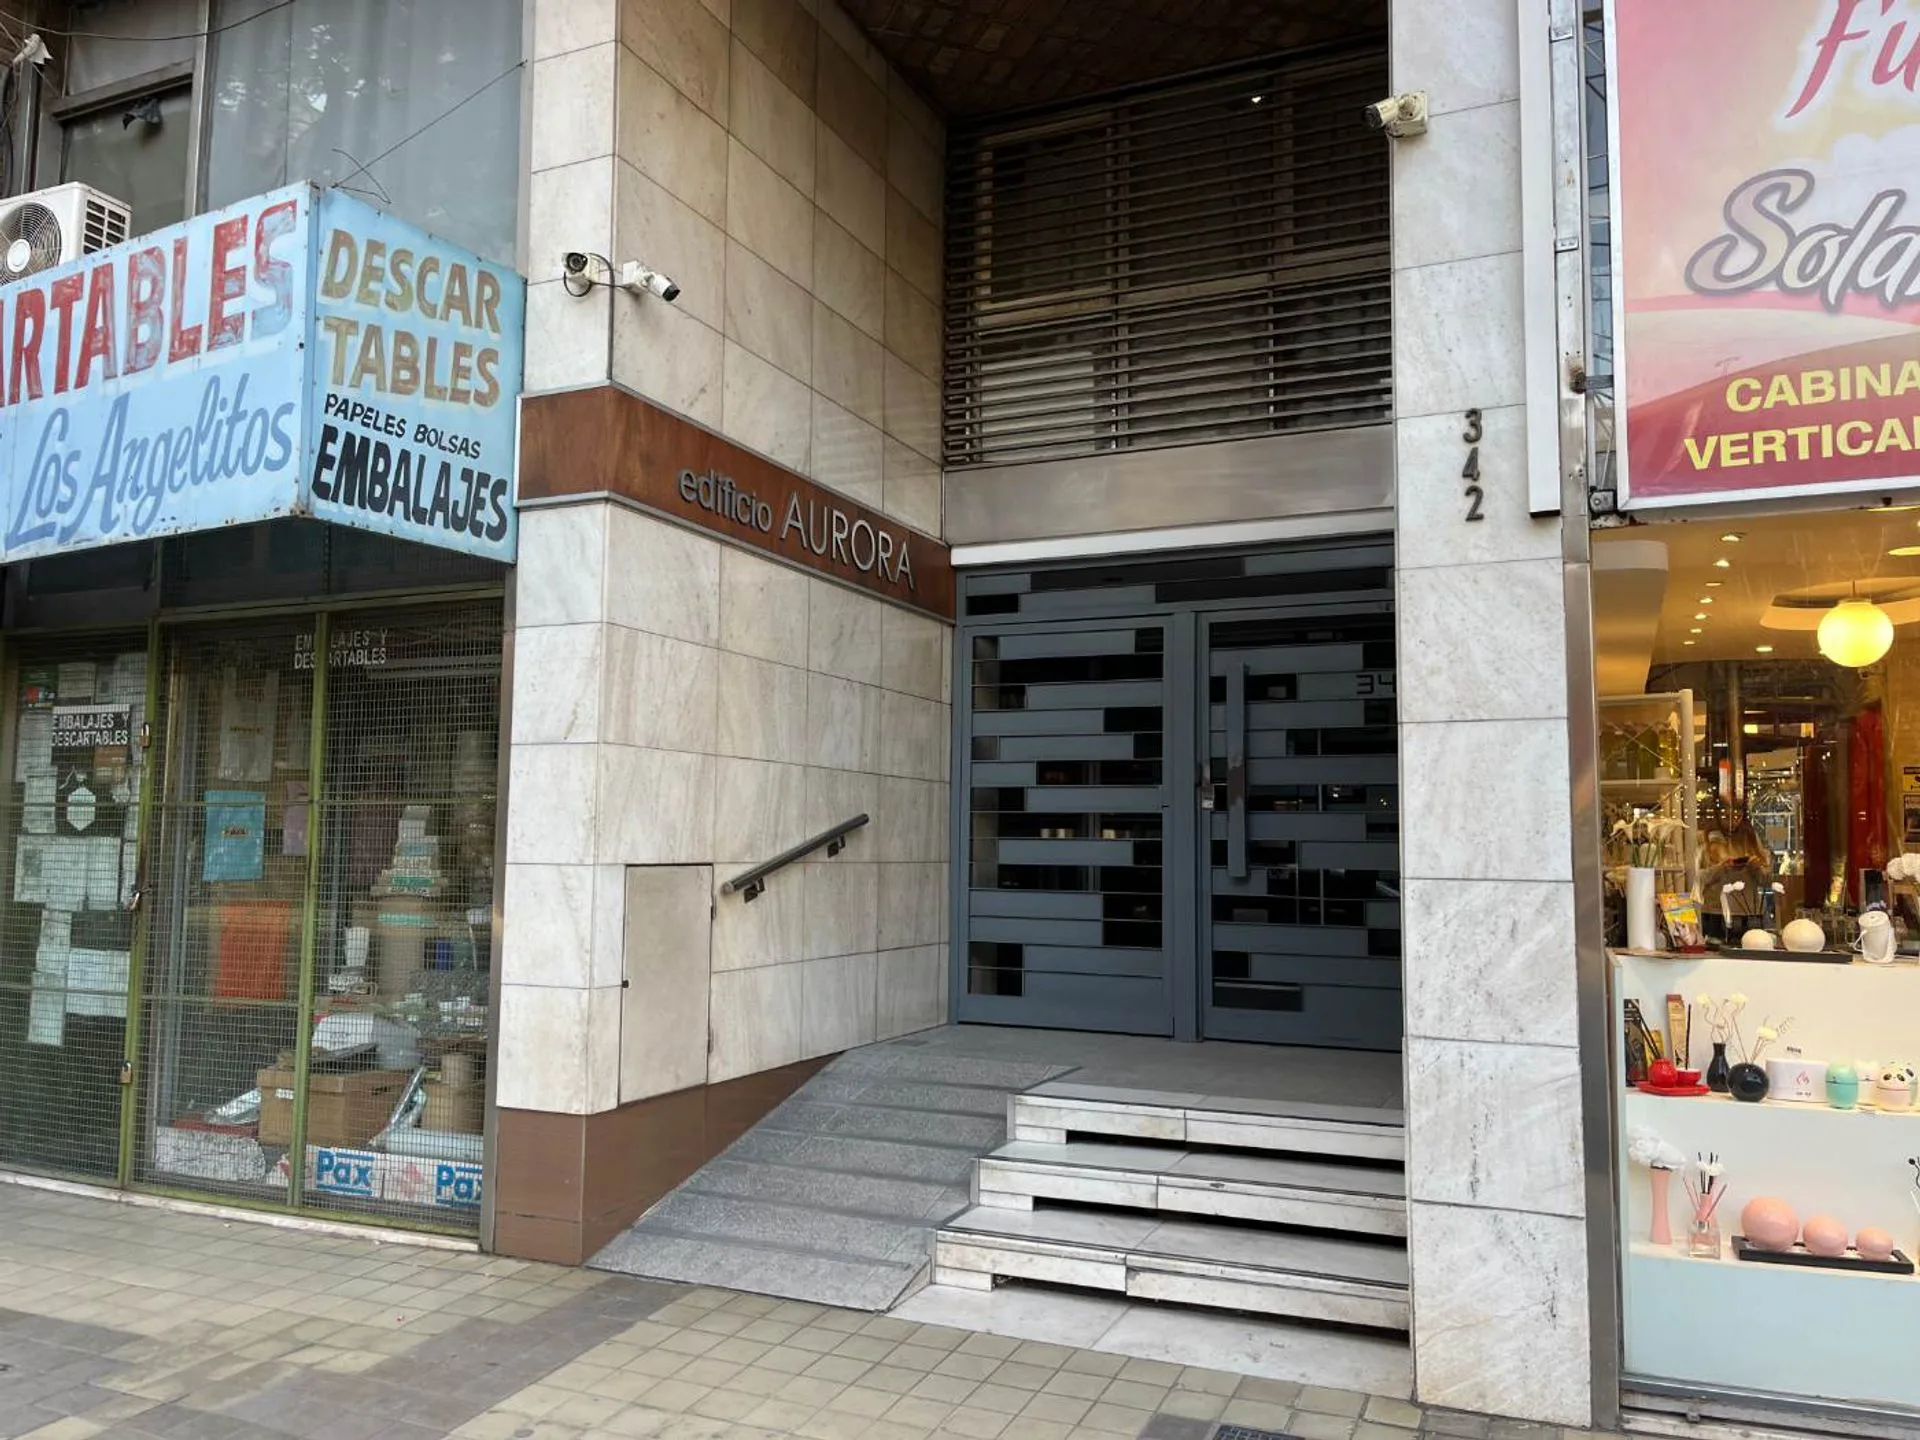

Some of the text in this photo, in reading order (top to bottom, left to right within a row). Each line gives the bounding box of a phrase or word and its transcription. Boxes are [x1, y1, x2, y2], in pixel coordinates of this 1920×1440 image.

[320, 228, 502, 335] DESCAR
[1684, 167, 1920, 314] Sola
[0, 199, 297, 408] RTABLES
[323, 315, 500, 408] TABLES
[1725, 360, 1920, 413] CABINA
[4, 373, 296, 550] Los Angelitos
[324, 393, 481, 459] PAPELES BOLSAS
[1462, 408, 1484, 522] 342
[311, 423, 508, 543] EMBALAJES
[679, 468, 914, 590] edificio AURORA
[380, 628, 388, 646] Y
[51, 713, 130, 731] EMBALAJES Y
[51, 730, 129, 747] DESCARTABLES
[317, 1150, 372, 1187] Pax
